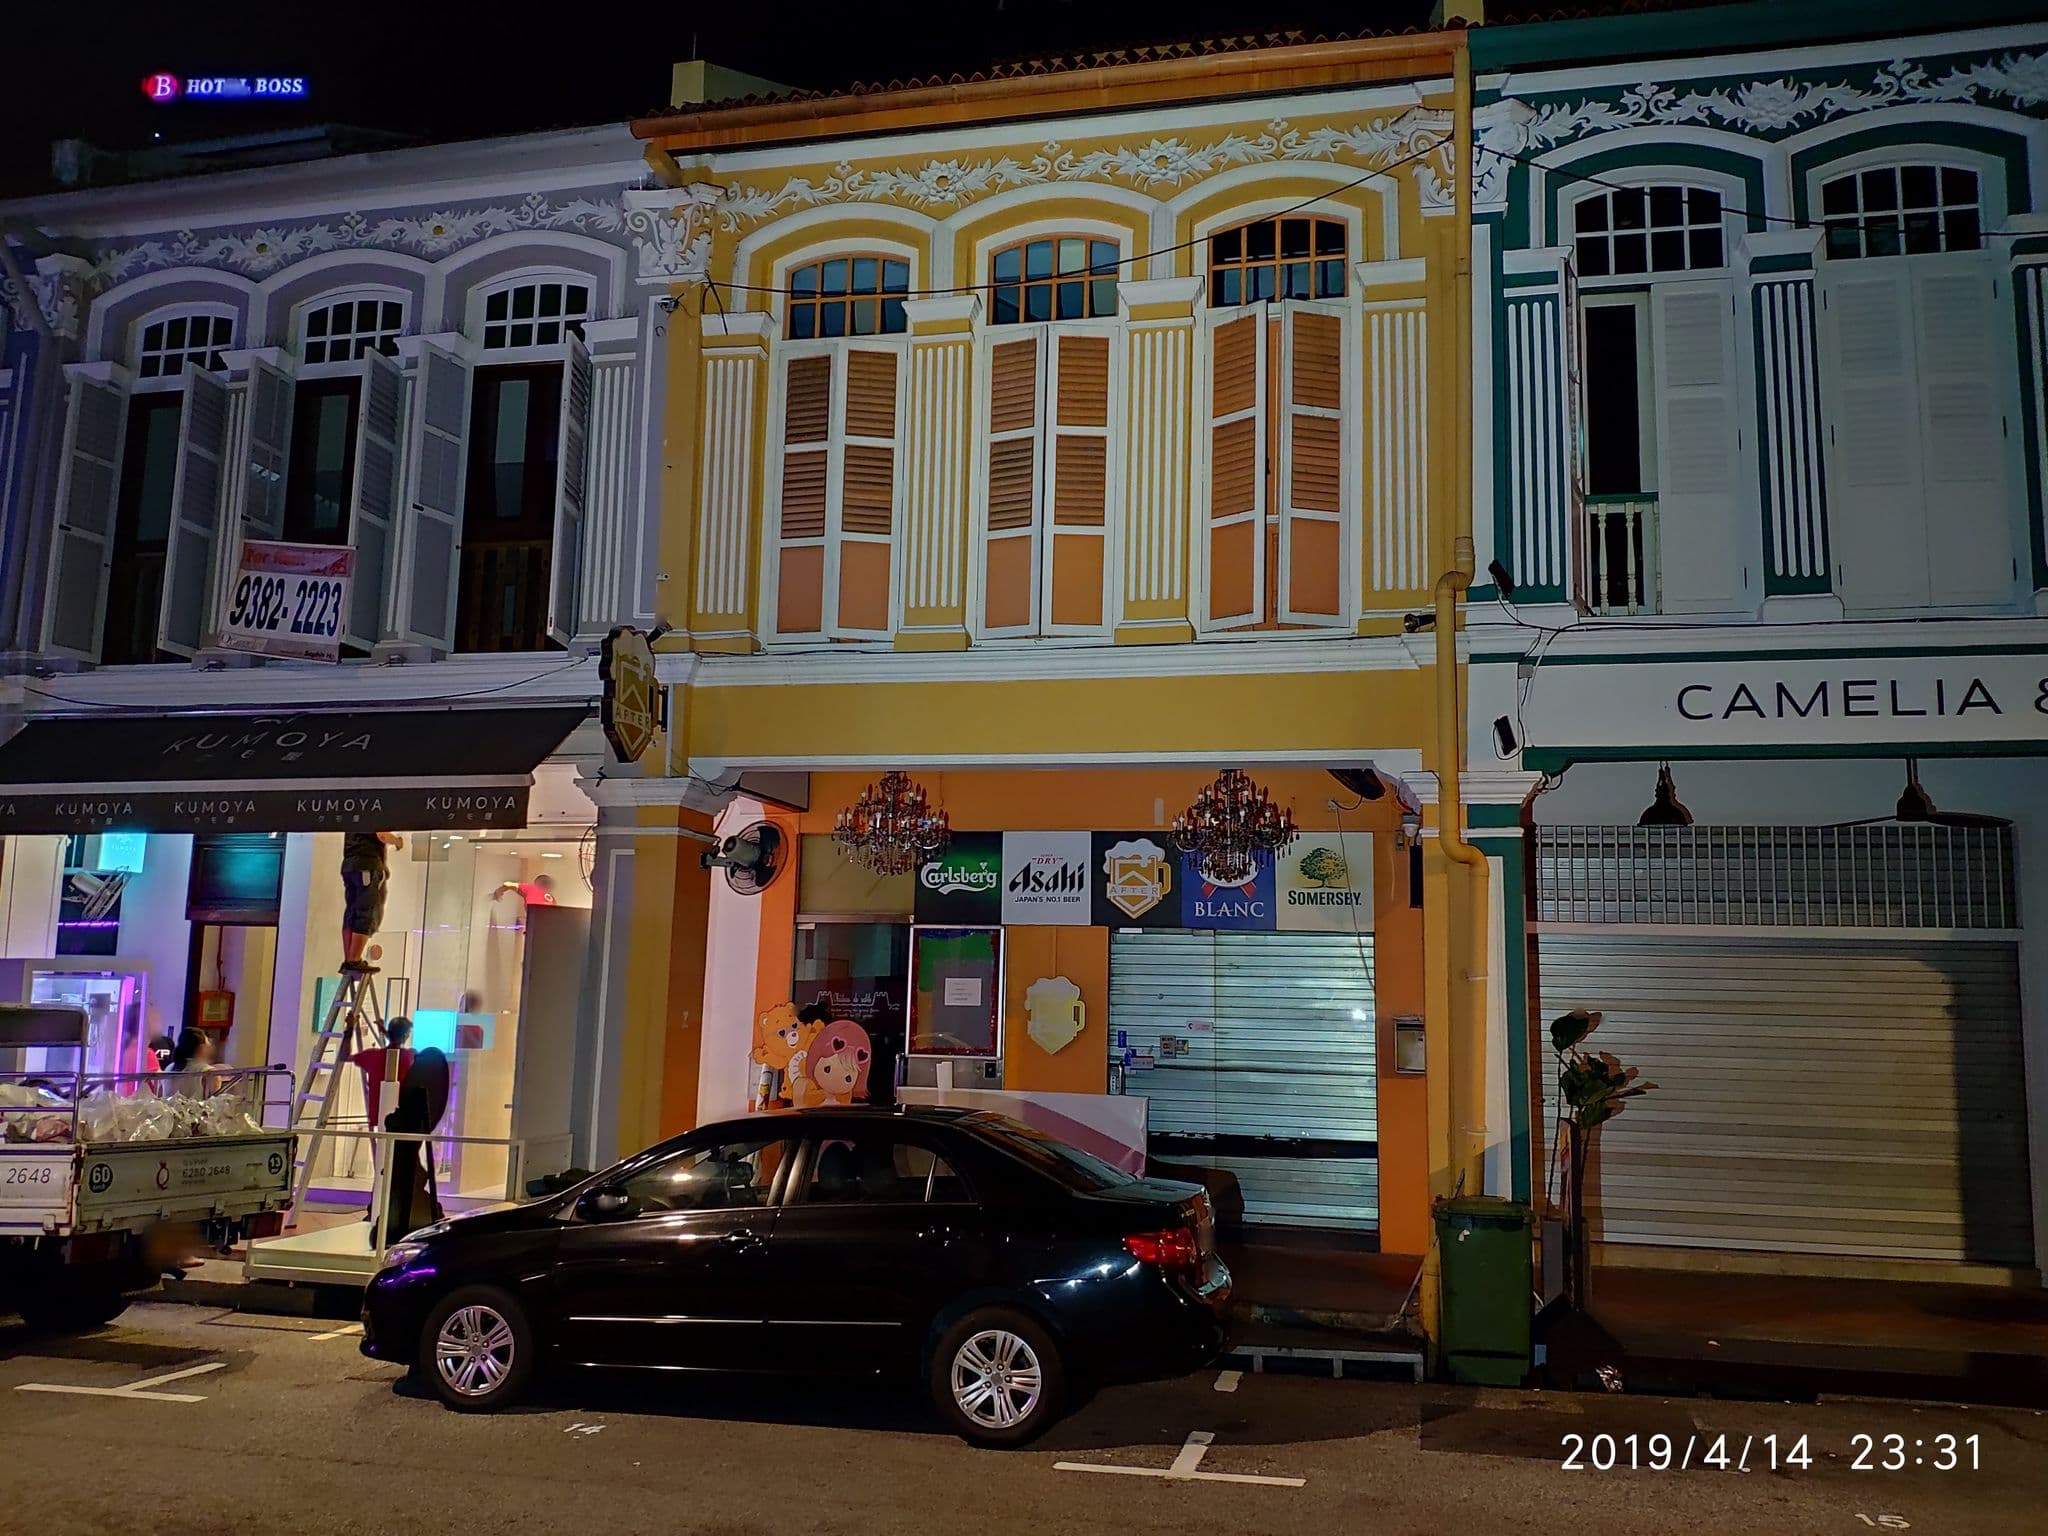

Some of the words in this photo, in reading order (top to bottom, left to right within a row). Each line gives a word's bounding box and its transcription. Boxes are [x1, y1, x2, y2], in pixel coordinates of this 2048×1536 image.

[186, 78, 251, 93] HOTL
[255, 78, 304, 93] BOSS
[289, 579, 342, 637] 2223
[1677, 678, 2004, 720] CAMELIA
[162, 731, 371, 754] KUMOYA
[55, 802, 134, 815] KUMOYA
[174, 800, 256, 814] KUMOYA
[297, 798, 383, 812] KUMOYA
[426, 796, 517, 810] KUMOYA
[920, 862, 998, 892] Carlsberg
[1009, 862, 1085, 893] Asahi
[1015, 895, 1044, 903] JAPAN'S
[1063, 895, 1081, 903] BEER
[1110, 885, 1159, 896] AFTER
[1194, 901, 1265, 918] BLANC
[6, 1167, 52, 1184] 2648
[207, 1165, 231, 1176] 2648
[1854, 1513, 1912, 1529] 15
